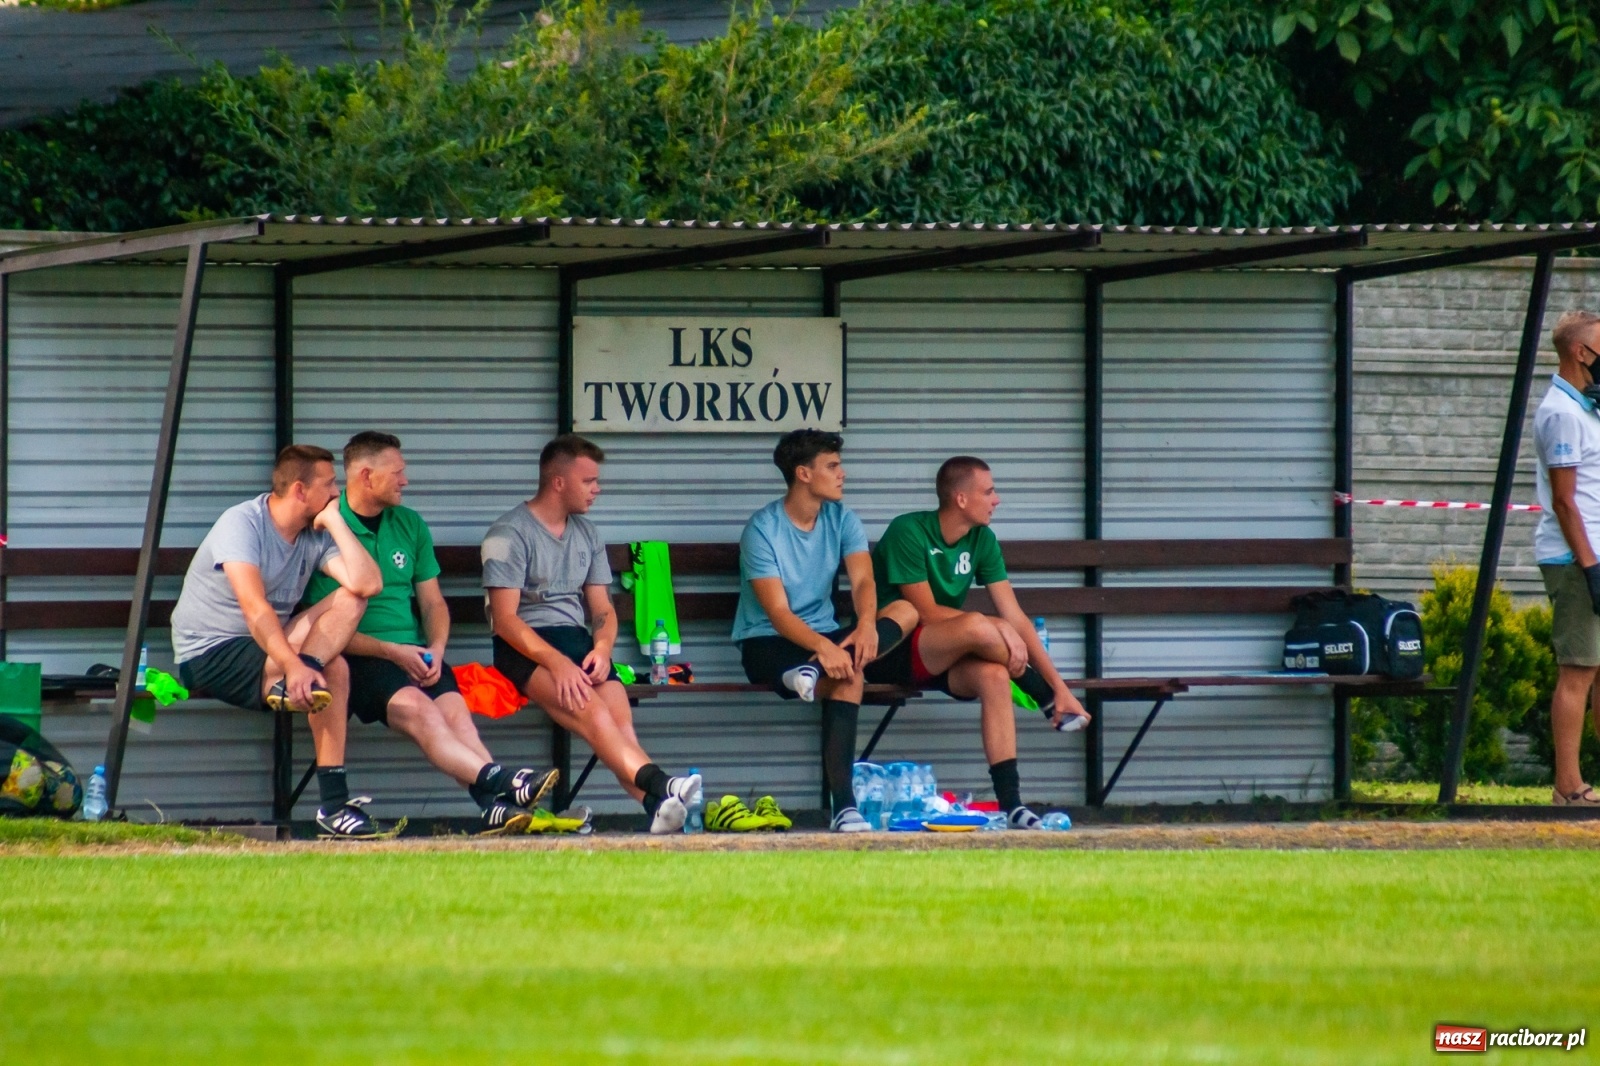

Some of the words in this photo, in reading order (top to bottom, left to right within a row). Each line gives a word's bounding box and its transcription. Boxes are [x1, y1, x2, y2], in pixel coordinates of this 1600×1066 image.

[668, 327, 753, 367] LKS
[584, 367, 832, 422] TWORKÓW
[1324, 643, 1353, 654] SELECT
[1398, 640, 1421, 650] SELECT
